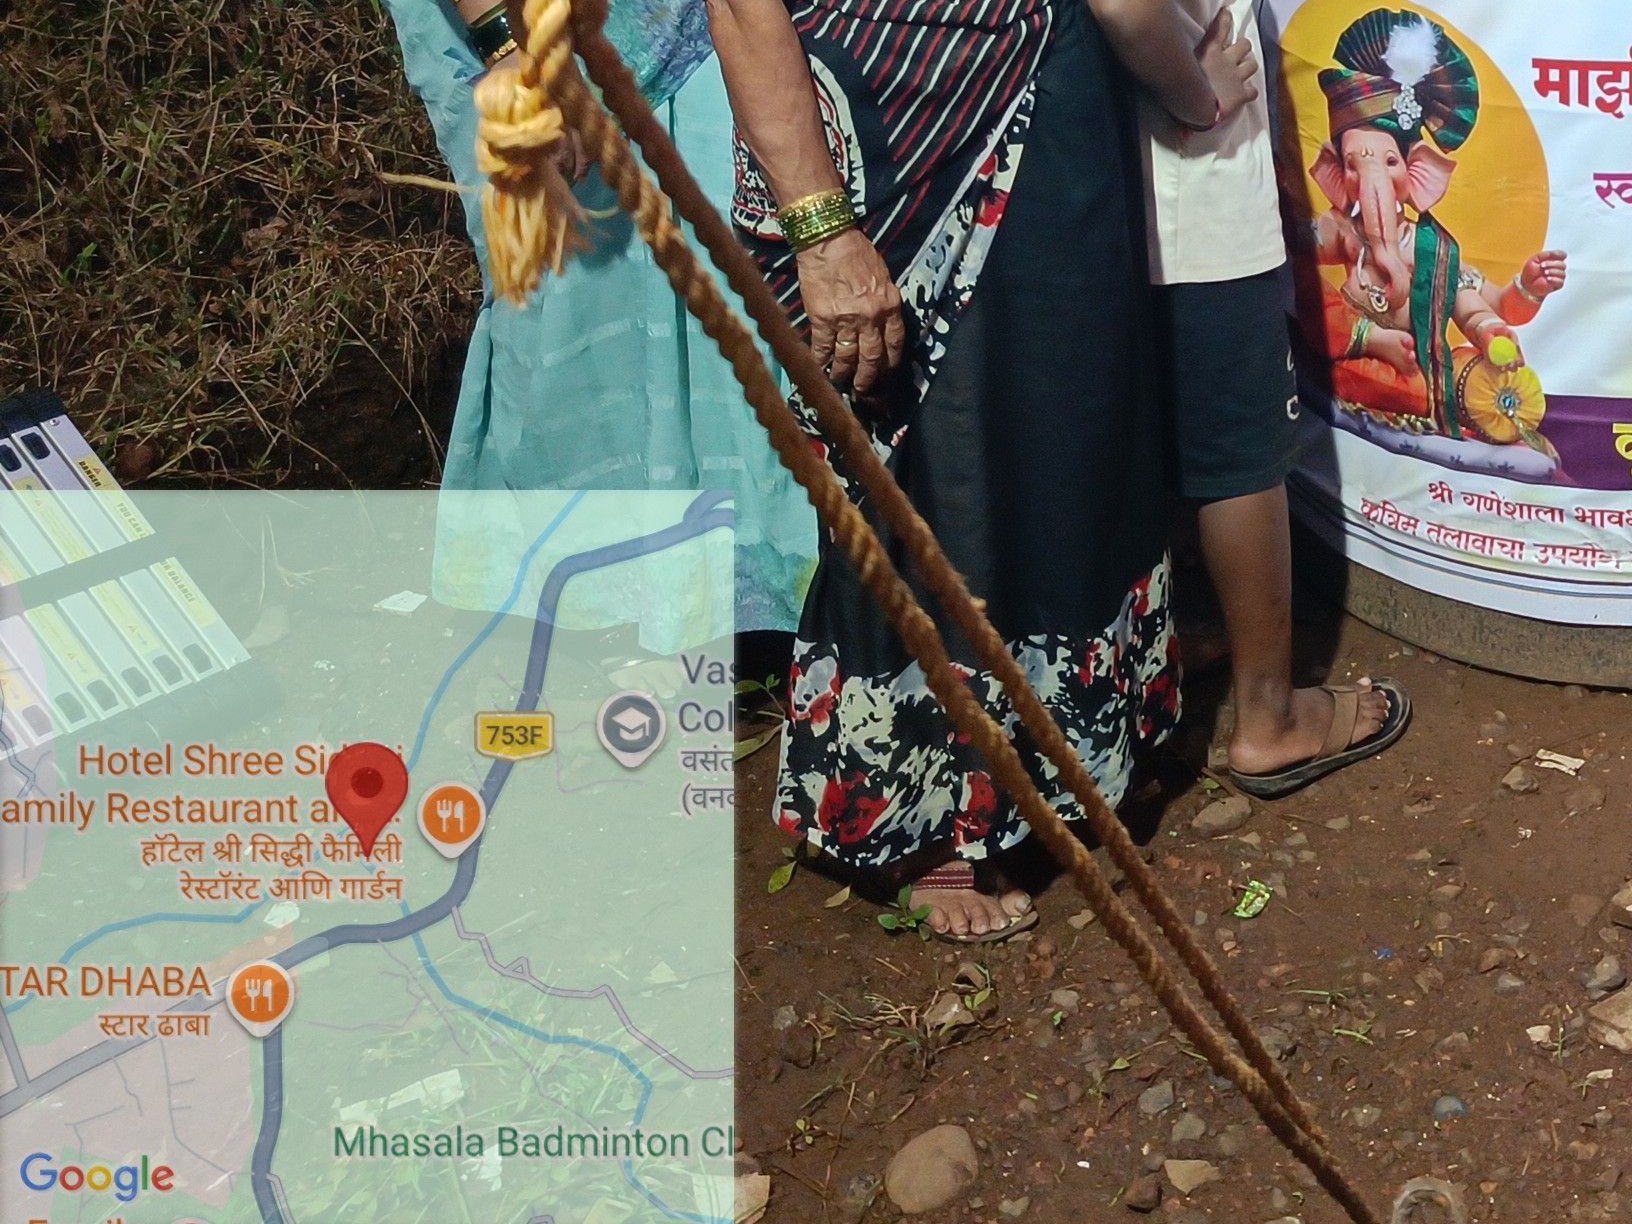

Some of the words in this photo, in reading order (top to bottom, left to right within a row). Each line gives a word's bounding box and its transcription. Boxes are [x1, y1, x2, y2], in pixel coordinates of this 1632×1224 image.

[1428, 481, 1454, 504] श्री
[1460, 490, 1566, 524] गणेशाला
[1425, 520, 1526, 561] तलावाचा
